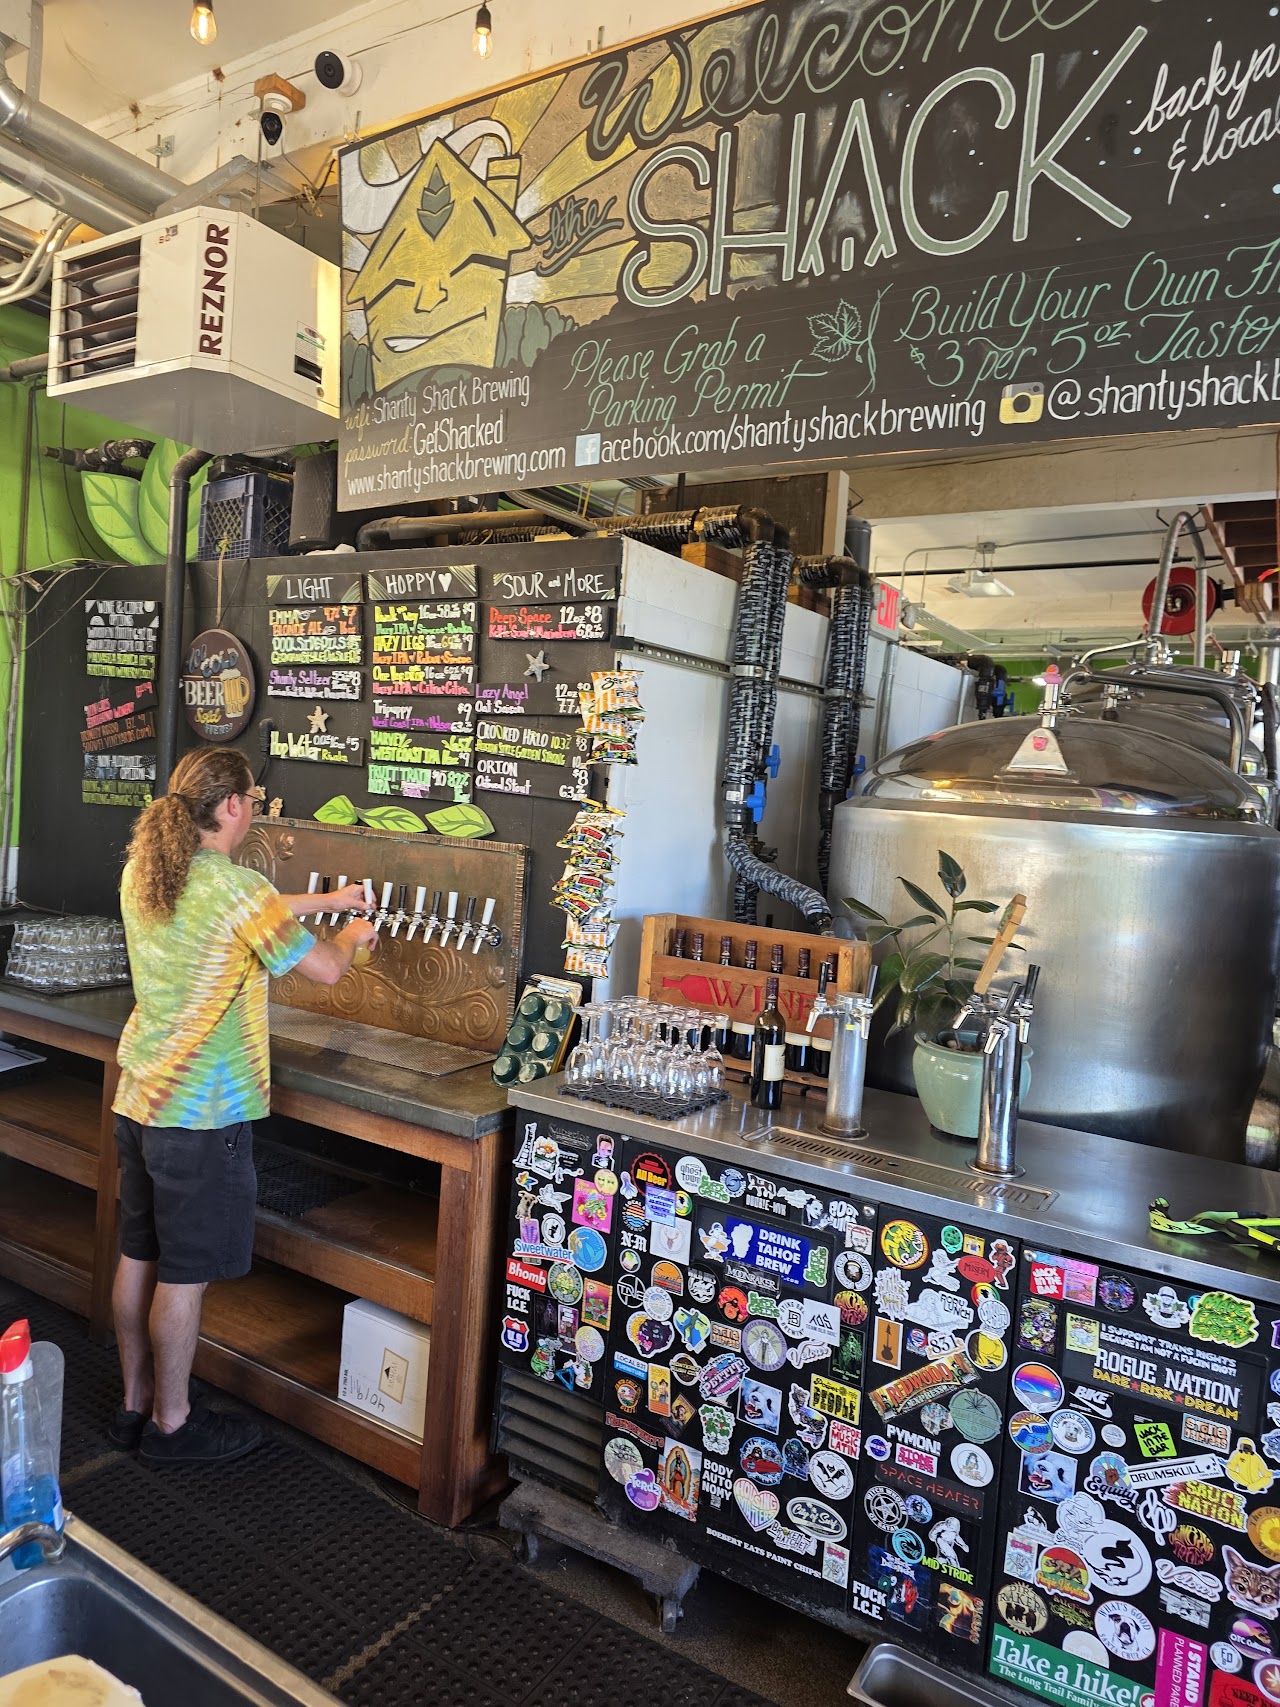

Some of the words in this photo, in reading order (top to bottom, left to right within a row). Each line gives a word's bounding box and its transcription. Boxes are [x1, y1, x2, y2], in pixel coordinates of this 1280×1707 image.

[1130, 40, 1280, 135] backya
[533, 195, 625, 257] the
[624, 26, 1147, 307] SHACK
[1168, 120, 1188, 205] &
[1191, 105, 1280, 173] loca
[199, 223, 231, 356] REZNOR
[893, 273, 1002, 342] Build
[1005, 267, 1112, 352] Your
[1124, 252, 1219, 311] Own
[1225, 237, 1280, 298] Fl
[563, 339, 655, 390] Please
[663, 317, 741, 376] Grab
[745, 332, 767, 363] a
[910, 341, 965, 387] $3
[965, 338, 1037, 404] per
[1046, 321, 1089, 373] 5
[374, 393, 417, 428] Shanty
[423, 380, 468, 414] Shack
[472, 371, 531, 408] Brewing
[582, 385, 677, 437] Parking
[689, 360, 815, 425] Permit
[344, 434, 413, 480] password:
[413, 409, 504, 457] GetShacked
[346, 445, 566, 495] www.shantyshackbrewing.com
[286, 577, 334, 602] LIGHT
[386, 570, 437, 595] HOPPY
[502, 572, 548, 600] SOUR
[563, 568, 611, 598] MORE
[392, 623, 410, 635] IPA
[489, 607, 518, 629] Deep
[519, 607, 553, 628] Space
[559, 606, 586, 625] 12oz
[585, 606, 603, 624] $8
[373, 635, 400, 653] HAZY
[401, 635, 425, 651] LEGS
[201, 648, 239, 678] COLD
[391, 651, 410, 664] IPA
[298, 669, 332, 686] Seltzer
[392, 682, 413, 695] IPA
[185, 680, 226, 706] BEER
[475, 684, 500, 703] Lazy
[502, 683, 529, 705] Angel
[458, 703, 472, 722] $9
[475, 700, 492, 714] Oat
[476, 722, 520, 743] CROOKED
[522, 728, 550, 748] HALO
[576, 736, 588, 752] $8
[371, 746, 397, 761] WEST
[477, 760, 518, 778] ORION
[572, 769, 589, 787] $8
[505, 778, 532, 795] Stout
[707, 977, 820, 1021] WINE
[636, 1169, 647, 1181] All
[647, 1171, 668, 1187] Beer
[681, 1163, 702, 1177] ghost
[516, 1239, 573, 1261] Sweetwater
[760, 1228, 801, 1252] DRINK
[756, 1255, 793, 1276] BREW
[757, 1242, 801, 1265] TAHOE
[509, 1263, 547, 1286] Bhomb
[726, 1263, 778, 1293] MOONRAKER
[963, 1262, 990, 1280] MISERY
[507, 1284, 532, 1302] FUCK
[943, 1300, 972, 1322] LUNCH
[929, 1334, 958, 1354] 831
[1099, 1332, 1135, 1349] BECAUSE
[1139, 1343, 1154, 1355] AM
[1153, 1347, 1173, 1360] NOT
[1101, 1322, 1107, 1332] I
[1107, 1325, 1157, 1344] SUPPORT
[1157, 1338, 1195, 1356] TRANS
[1195, 1348, 1238, 1368] RIGHTS
[617, 1354, 636, 1366] LOCAL
[886, 1362, 954, 1408] REDWOOD
[1094, 1347, 1158, 1384] ROGUE
[1164, 1366, 1242, 1409] NATION
[1074, 1385, 1111, 1405] BIKE
[1093, 1368, 1131, 1388] DARE
[1139, 1382, 1174, 1402] RISK
[1184, 1396, 1239, 1421] DREAM
[831, 1430, 860, 1448] MUSIC
[1139, 1425, 1163, 1440] JACK
[1143, 1438, 1155, 1448] IN
[1154, 1432, 1170, 1444] THE
[830, 1441, 859, 1459] LATIN
[900, 1446, 934, 1467] STONE
[1148, 1443, 1170, 1457] BAR
[703, 1472, 734, 1489] AUTO
[704, 1459, 735, 1478] BODY
[1130, 1465, 1205, 1484] DRUMSKULL
[701, 1482, 733, 1502] NOMY
[737, 1480, 778, 1508] HOUSING
[880, 1463, 923, 1489] SPACE
[926, 1482, 979, 1510] HEATER
[1086, 1476, 1137, 1514] Equity
[1185, 1480, 1243, 1511] SAUCE
[792, 1503, 810, 1520] City
[1177, 1493, 1244, 1529] NATION
[1249, 1511, 1263, 1529] The
[707, 1528, 744, 1547] BOEBERT
[743, 1541, 766, 1557] EATS
[766, 1551, 793, 1568] PAINT
[776, 1533, 811, 1554] HATCHET
[922, 1555, 941, 1571] MID
[941, 1563, 975, 1586] STRIDE
[854, 1581, 888, 1607] FUCK
[998, 1593, 1048, 1618] RAKERS
[853, 1599, 884, 1621] I.C.E.
[1098, 1600, 1128, 1621] WHAT'S
[1130, 1608, 1152, 1632] GOOD
[1099, 1632, 1119, 1656] SANTA
[994, 1634, 1051, 1676] Take
[1053, 1662, 1069, 1687] a
[1073, 1662, 1140, 1707] hike!
[1171, 1637, 1186, 1682] PLANNED
[998, 1665, 1018, 1680] The
[1018, 1672, 1042, 1692] Long
[1043, 1680, 1065, 1698] Trail
[1066, 1688, 1099, 1707] Family
[1184, 1650, 1204, 1704] STAND
